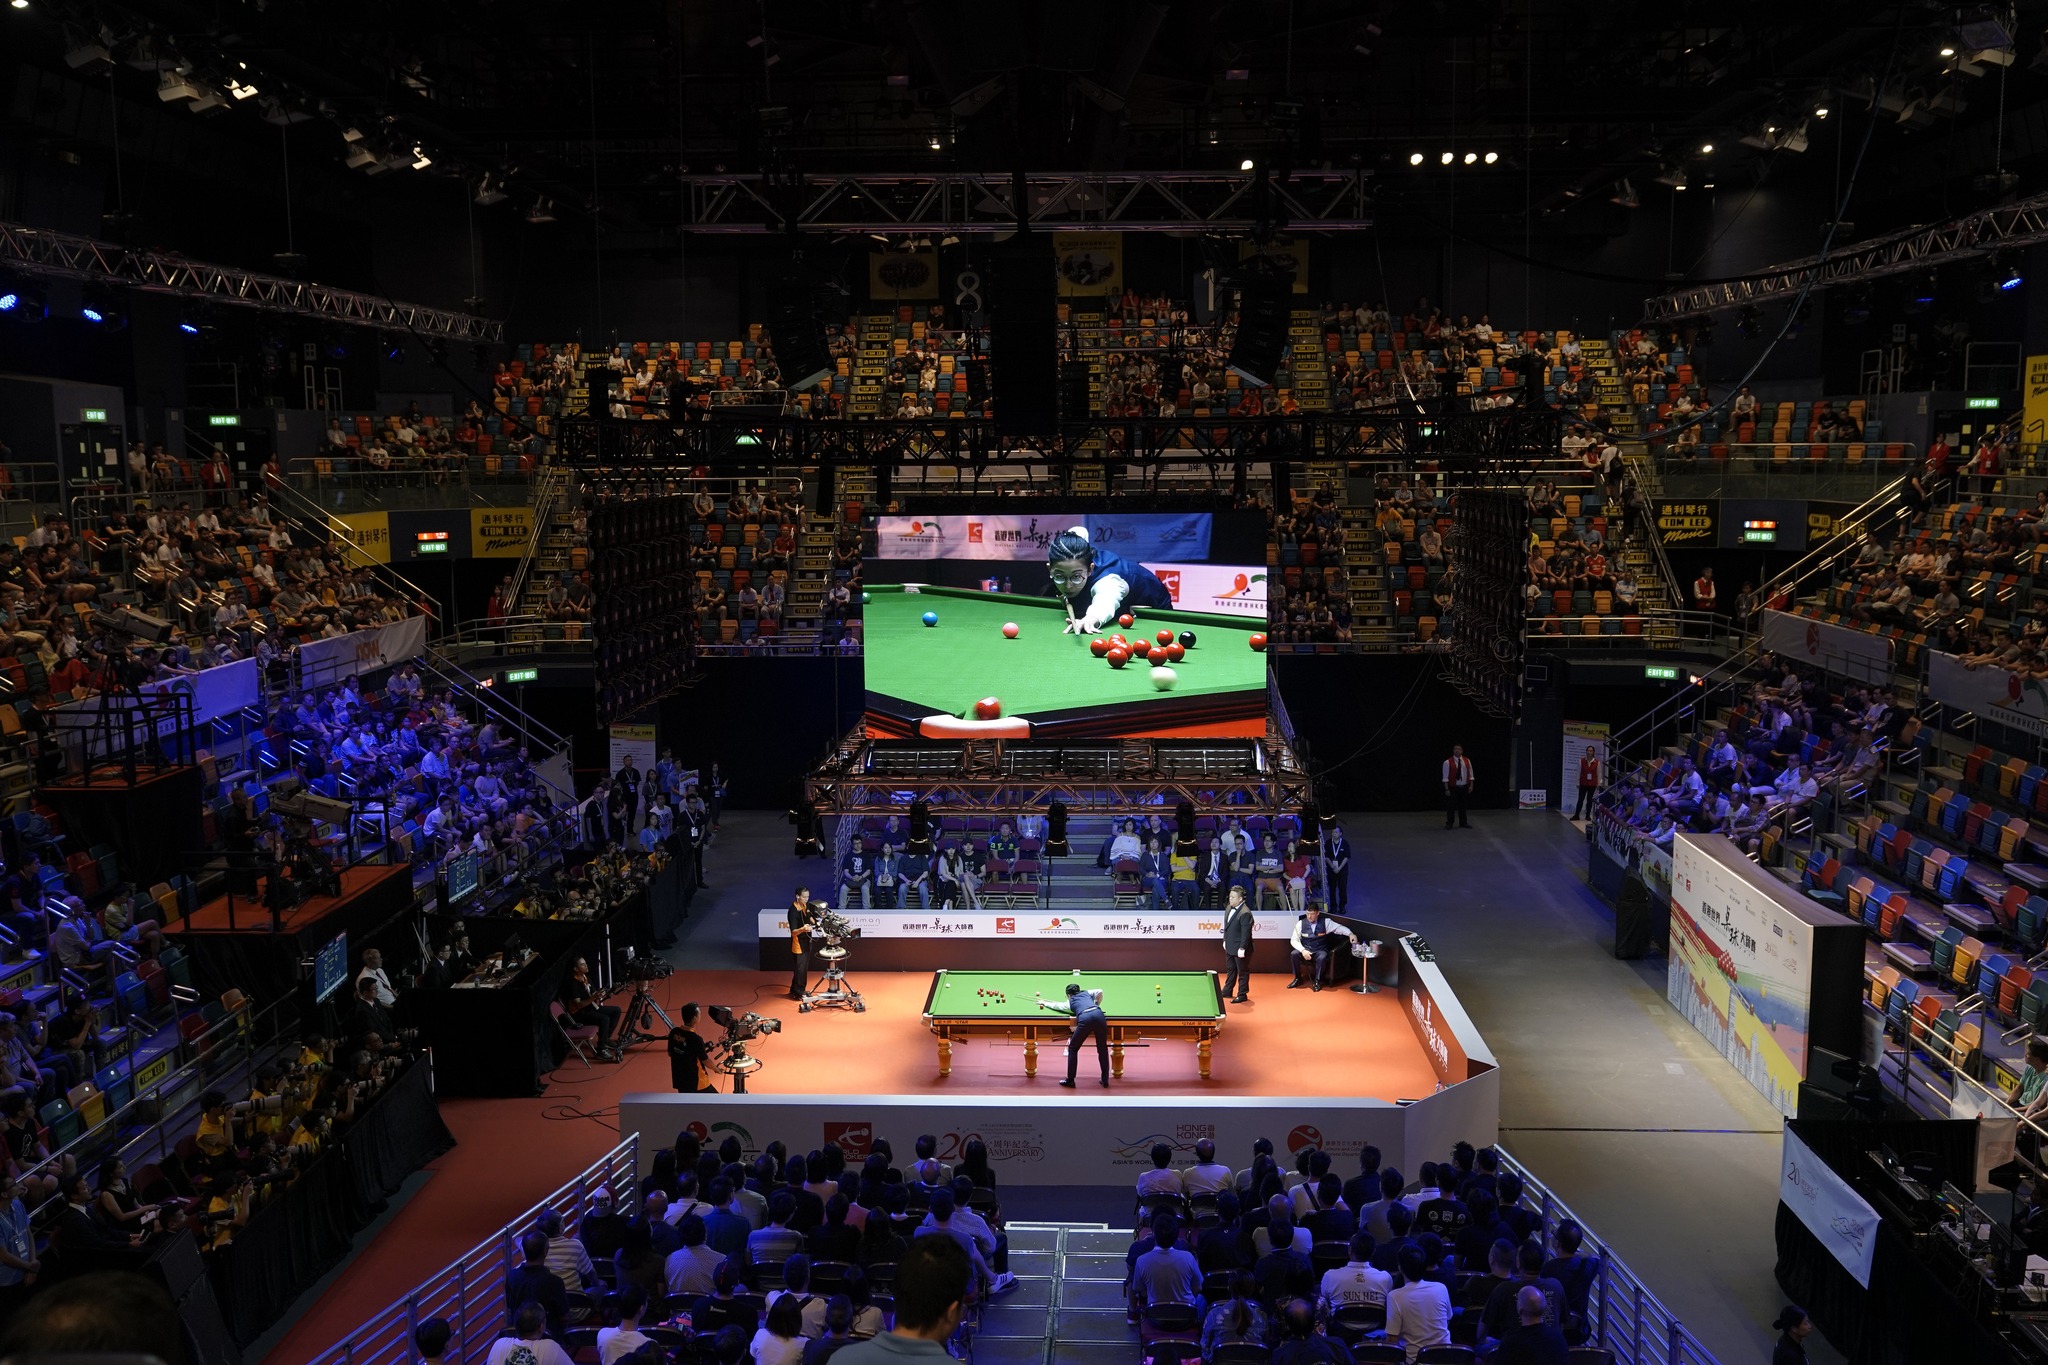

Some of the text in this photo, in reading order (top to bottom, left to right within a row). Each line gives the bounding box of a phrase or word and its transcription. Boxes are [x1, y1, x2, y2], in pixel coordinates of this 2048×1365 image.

[1661, 505, 1708, 515] 通利琴行
[481, 514, 524, 524] 通利琴行
[1664, 518, 1707, 527] TOM LEE
[483, 527, 524, 535] TOM LEE
[1198, 921, 1221, 930] now
[1176, 1124, 1206, 1132] HONG
[988, 1148, 1041, 1157] ANNIVERSARY
[1343, 1291, 1378, 1301] SUN HEI
